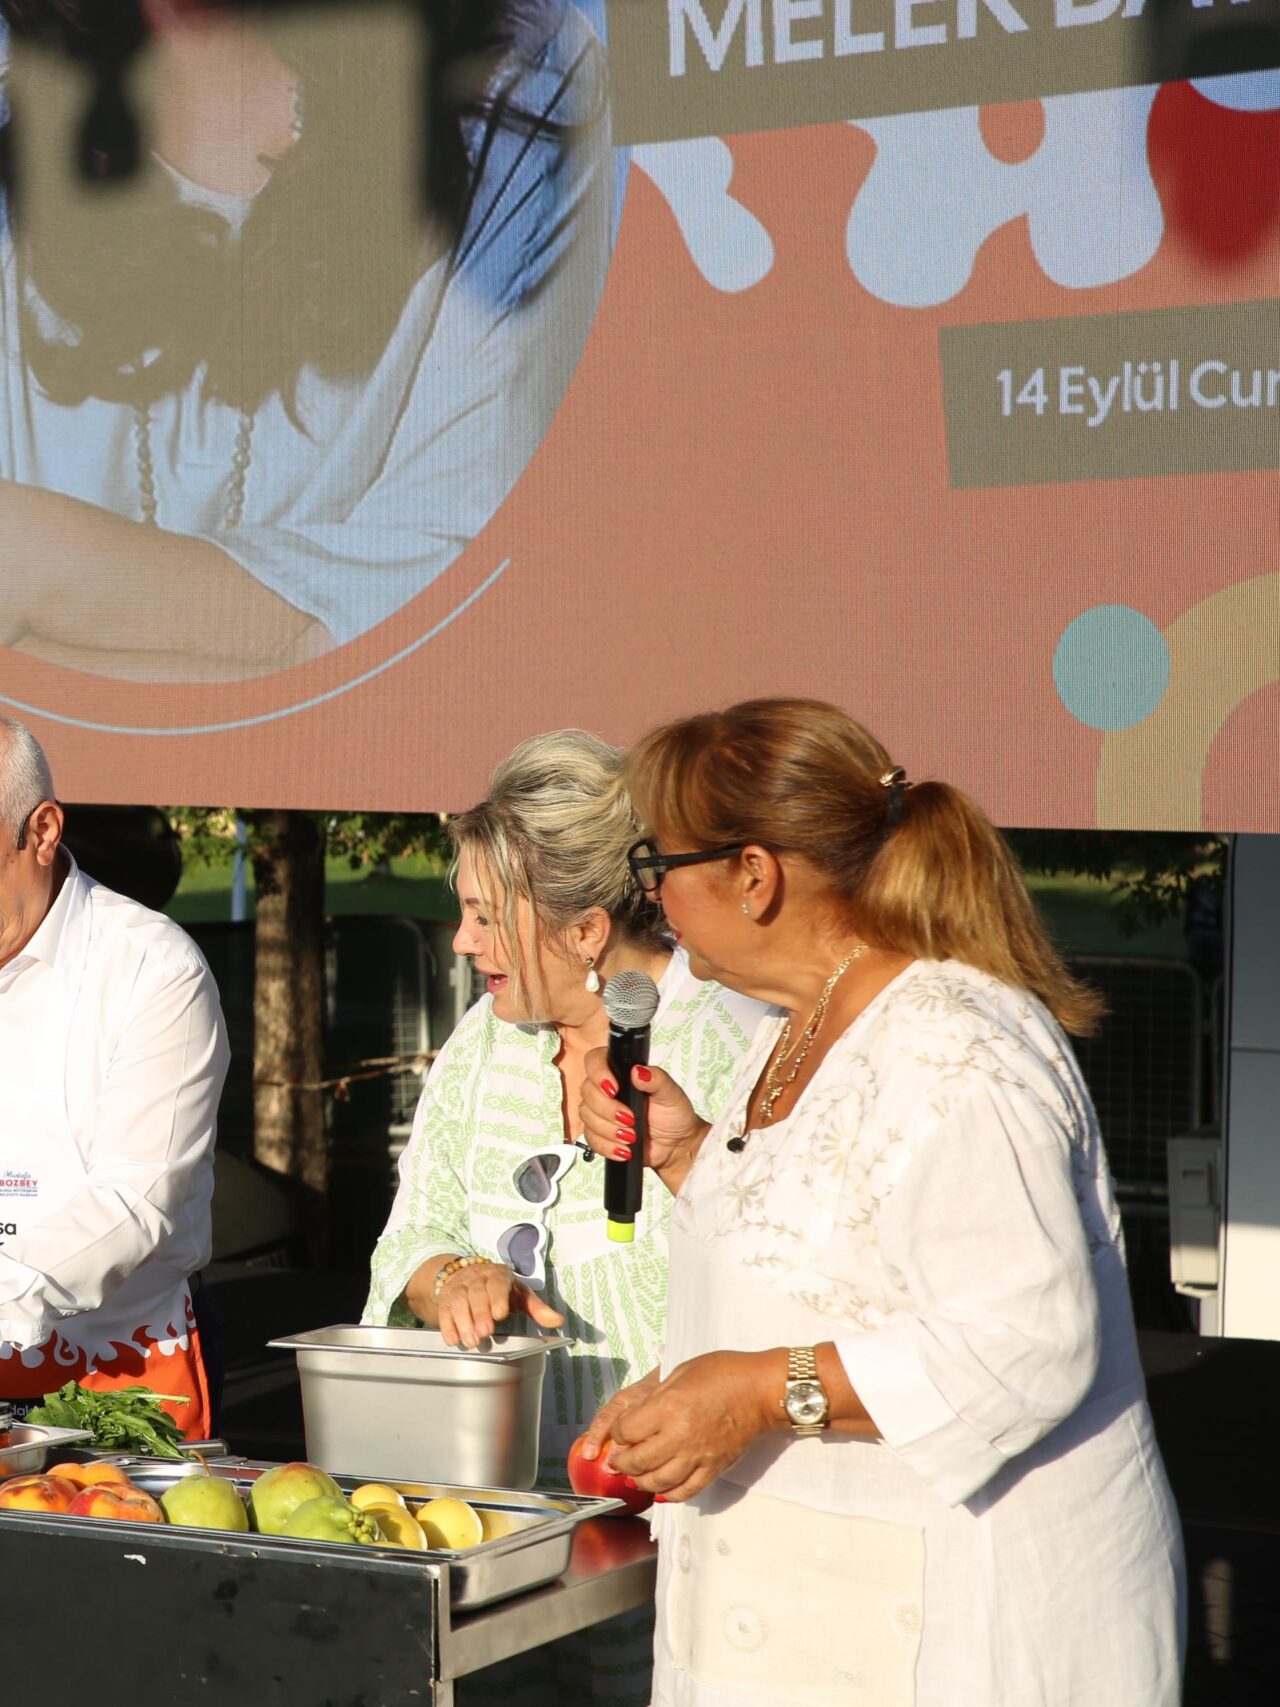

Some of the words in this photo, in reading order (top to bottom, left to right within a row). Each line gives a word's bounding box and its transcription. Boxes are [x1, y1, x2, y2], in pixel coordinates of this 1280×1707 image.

[996, 367, 1048, 416] 14
[1059, 359, 1179, 427] Eylül
[0, 1179, 38, 1187] BOZBEY
